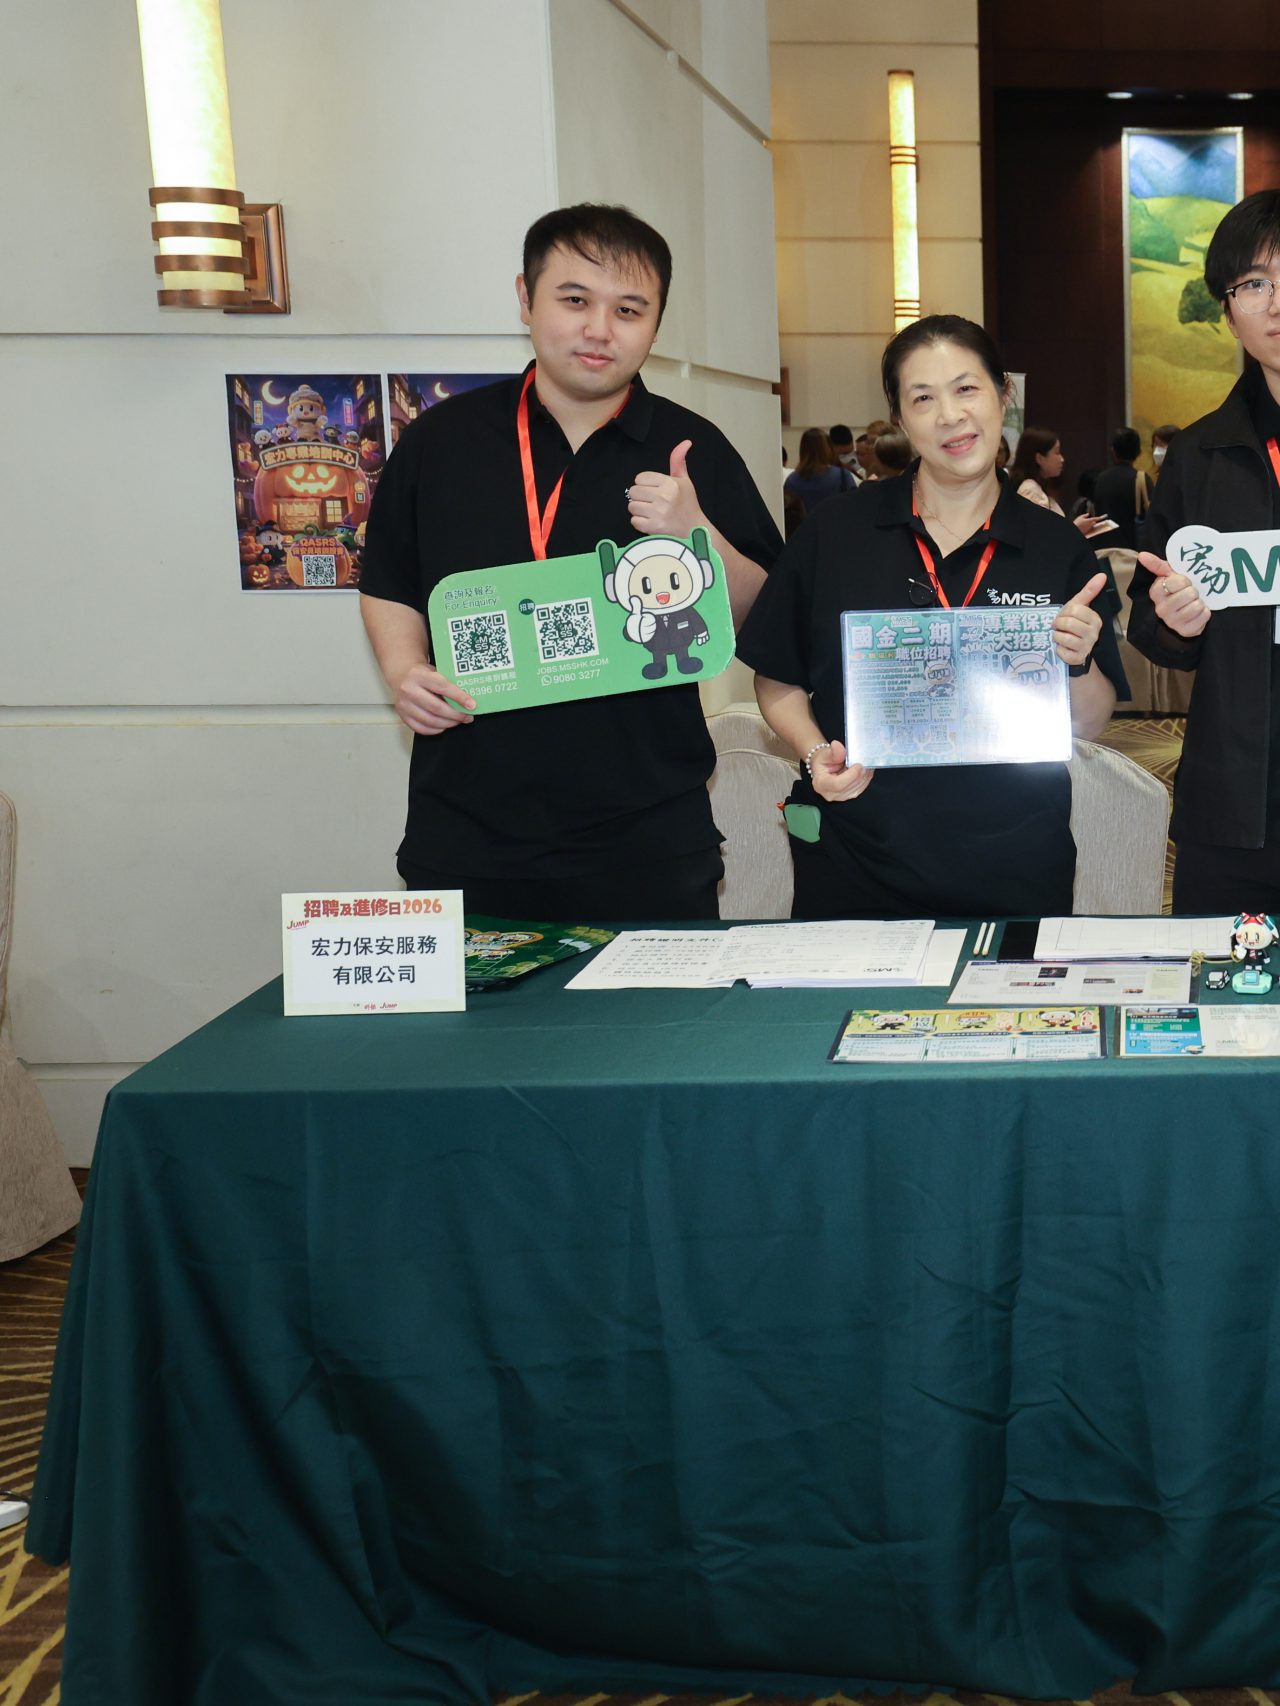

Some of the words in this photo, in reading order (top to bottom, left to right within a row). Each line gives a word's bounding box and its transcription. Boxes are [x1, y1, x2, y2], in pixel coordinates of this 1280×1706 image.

[300, 538, 337, 547] QASRS
[463, 598, 498, 610] Enquiry
[1001, 592, 1051, 607] MSS
[519, 602, 535, 613] 招聘
[852, 623, 952, 650] 國金二期
[537, 658, 609, 675] JOBS.MSSHK.COM
[553, 674, 576, 685] 9080
[579, 669, 601, 680] 3277
[494, 682, 518, 693] 0722
[311, 935, 437, 957] 宏力保安服務
[333, 965, 416, 985] 有限公司
